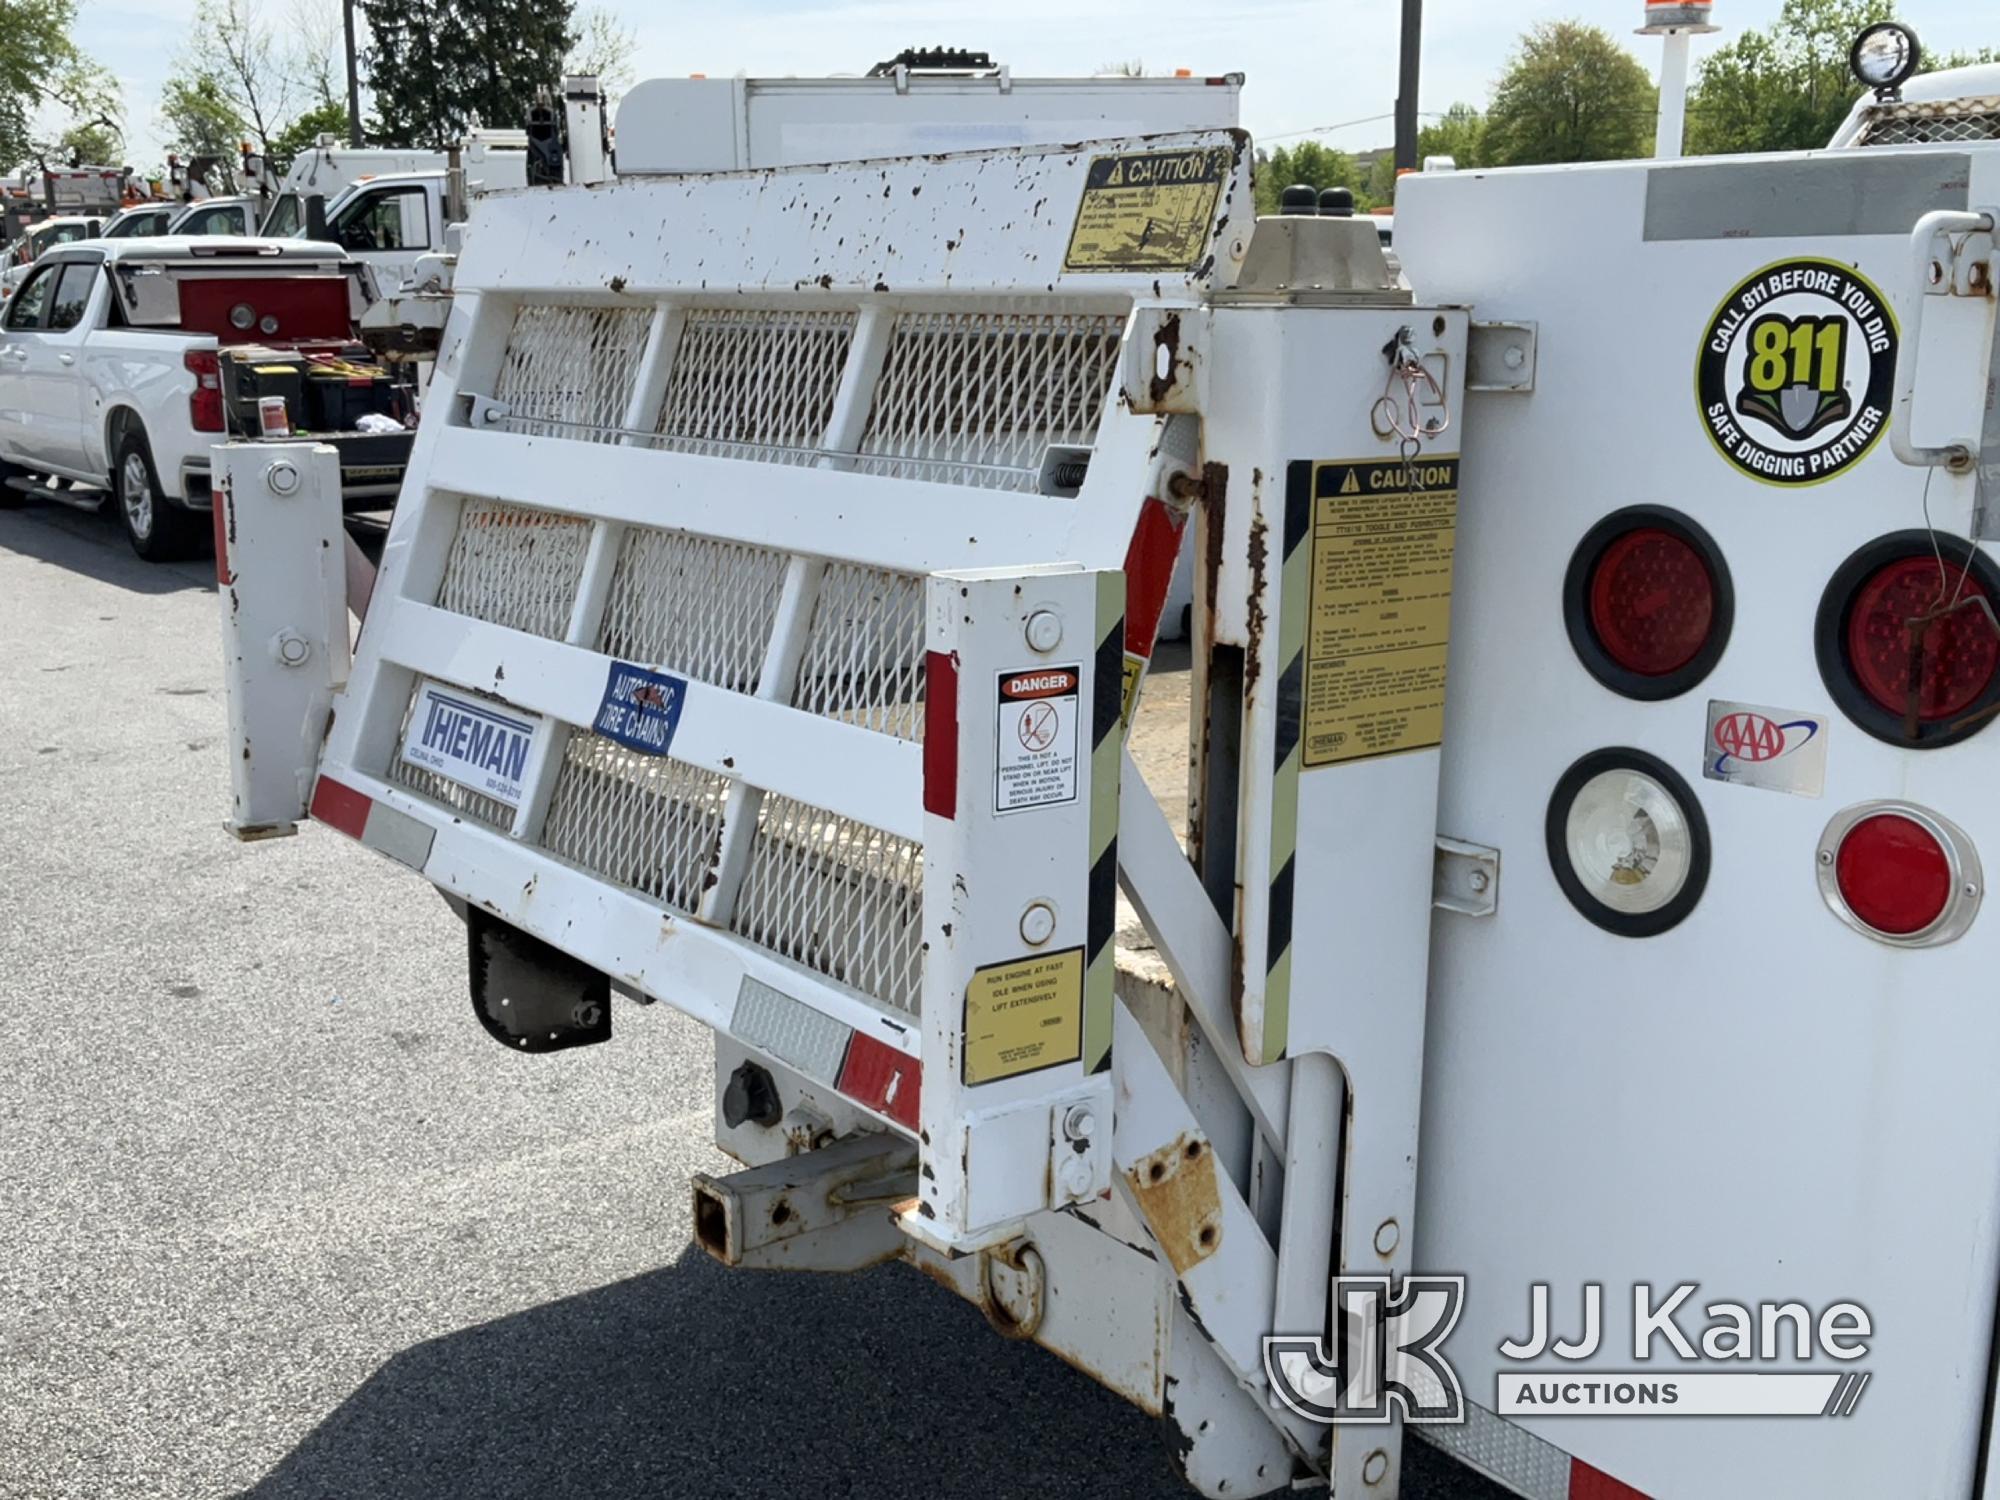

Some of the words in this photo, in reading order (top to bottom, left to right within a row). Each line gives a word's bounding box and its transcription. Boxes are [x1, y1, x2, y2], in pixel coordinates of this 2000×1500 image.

[1128, 156, 1206, 182] CAUTION
[1711, 308, 1746, 354] CALL
[1742, 282, 1770, 311] 811
[1769, 269, 1841, 295] BEFORE
[1840, 281, 1874, 320] YOU
[1864, 315, 1890, 354] DIG
[1749, 320, 1842, 392] 811
[1708, 401, 1741, 449] SAFE
[1735, 440, 1805, 477] DIGGING
[1809, 405, 1884, 474] PARTNER
[1369, 466, 1451, 489] CAUTION
[1011, 675, 1068, 693] DANGER
[421, 690, 534, 782] THIEMAN
[599, 704, 626, 733] TIRE
[624, 711, 669, 747] CHAINS
[1718, 713, 1781, 761] AAA
[986, 976, 1002, 984] RUN
[1005, 969, 1031, 980] ENGINE
[1034, 966, 1044, 974] AT
[1046, 961, 1064, 971] FAST
[992, 988, 1008, 998] IDLE
[1012, 982, 1033, 993] WHEN
[1035, 977, 1058, 988] USING
[992, 1002, 1008, 1012] LIFT
[1010, 992, 1057, 1009] EXTENSIVELY
